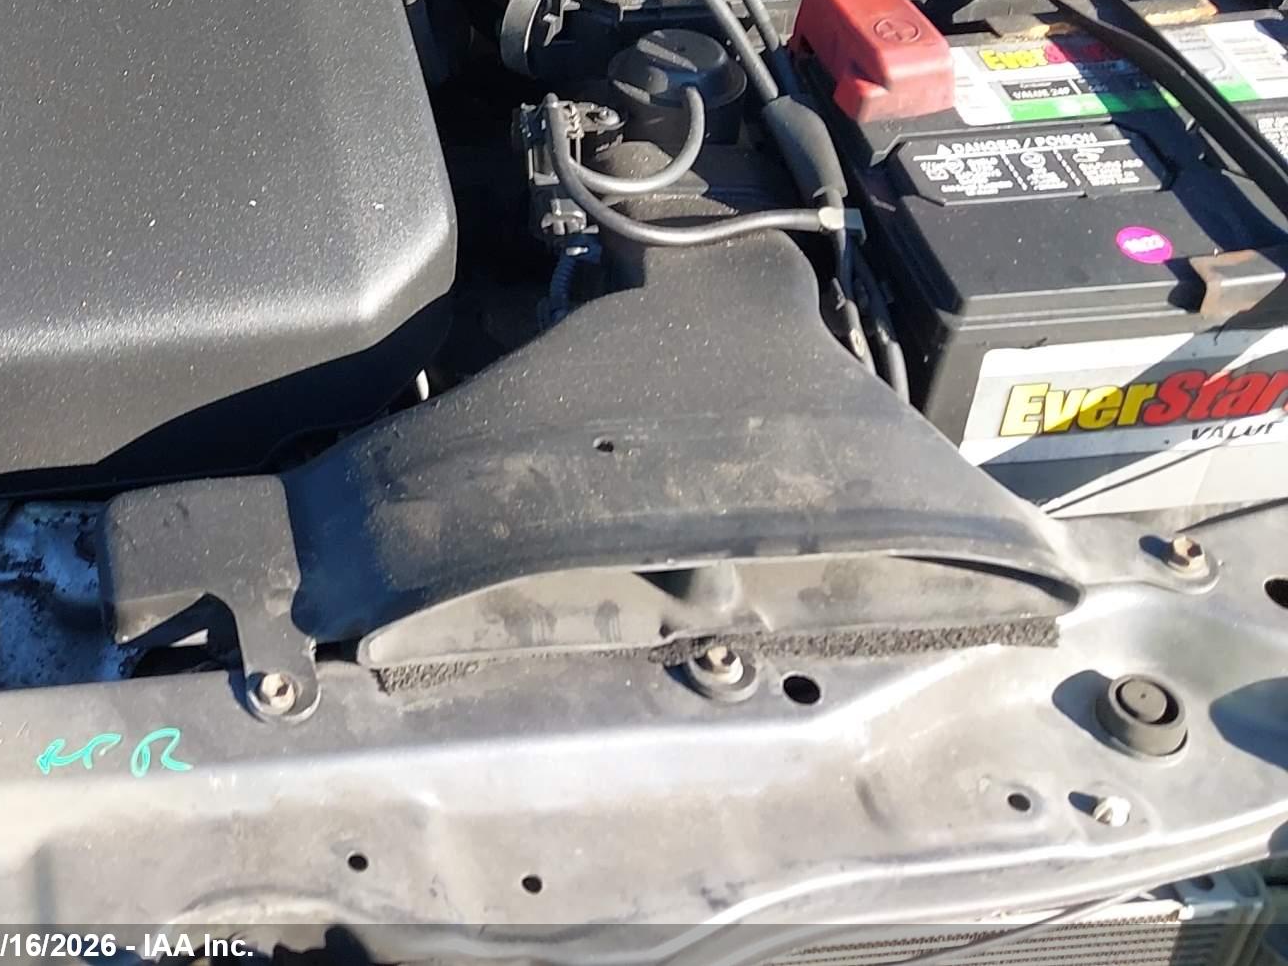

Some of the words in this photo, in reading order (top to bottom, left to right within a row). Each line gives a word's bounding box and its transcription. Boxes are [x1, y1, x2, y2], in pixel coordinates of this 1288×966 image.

[951, 139, 1021, 155] DANGER
[1035, 132, 1098, 147] POISON
[998, 368, 1288, 437] EverStar
